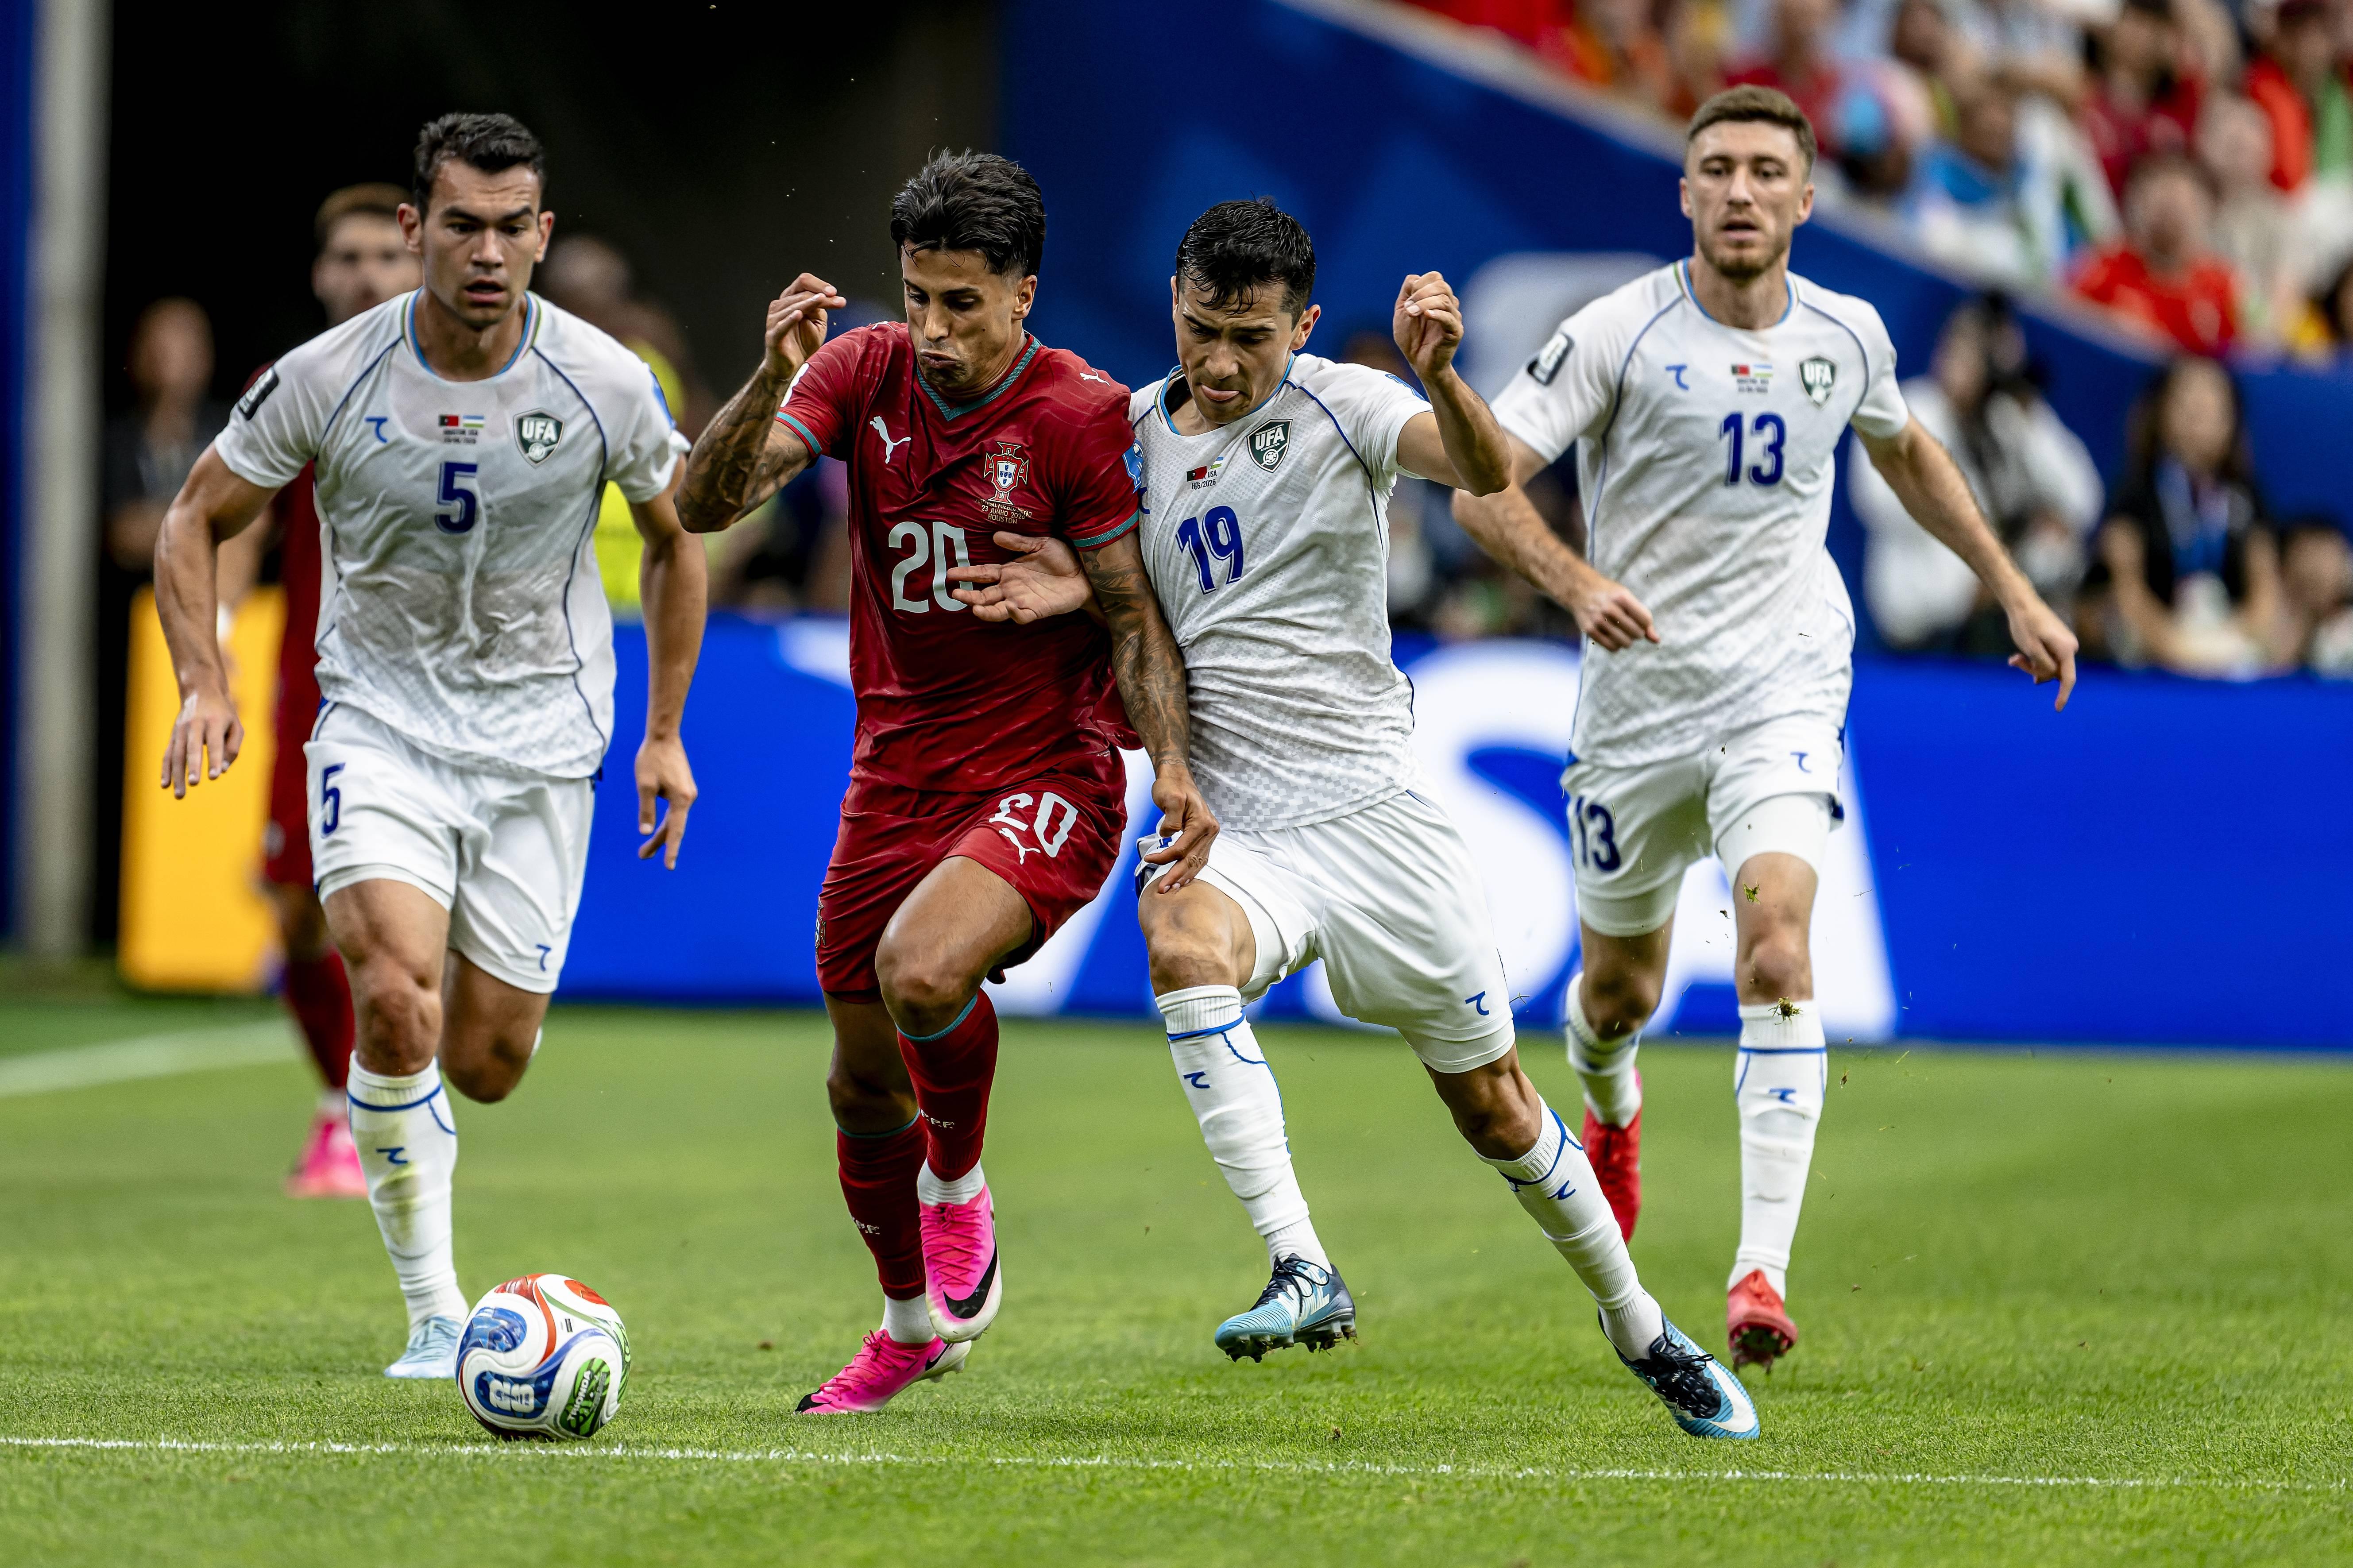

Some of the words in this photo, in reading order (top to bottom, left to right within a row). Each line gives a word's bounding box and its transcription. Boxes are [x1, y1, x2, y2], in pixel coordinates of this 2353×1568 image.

[1804, 363, 1833, 384] UFA
[522, 419, 557, 442] UFA
[1256, 426, 1285, 450] UFA
[1719, 412, 1786, 486] 13
[434, 461, 478, 535] 5
[988, 513, 1017, 524] HOUSTON
[990, 507, 1008, 516] JUNHO
[888, 521, 973, 613] 20
[1175, 505, 1244, 595] 19
[321, 762, 346, 839] 5
[989, 792, 1079, 858] 20
[1576, 796, 1621, 873] 13
[567, 1370, 591, 1421] TRIONDA
